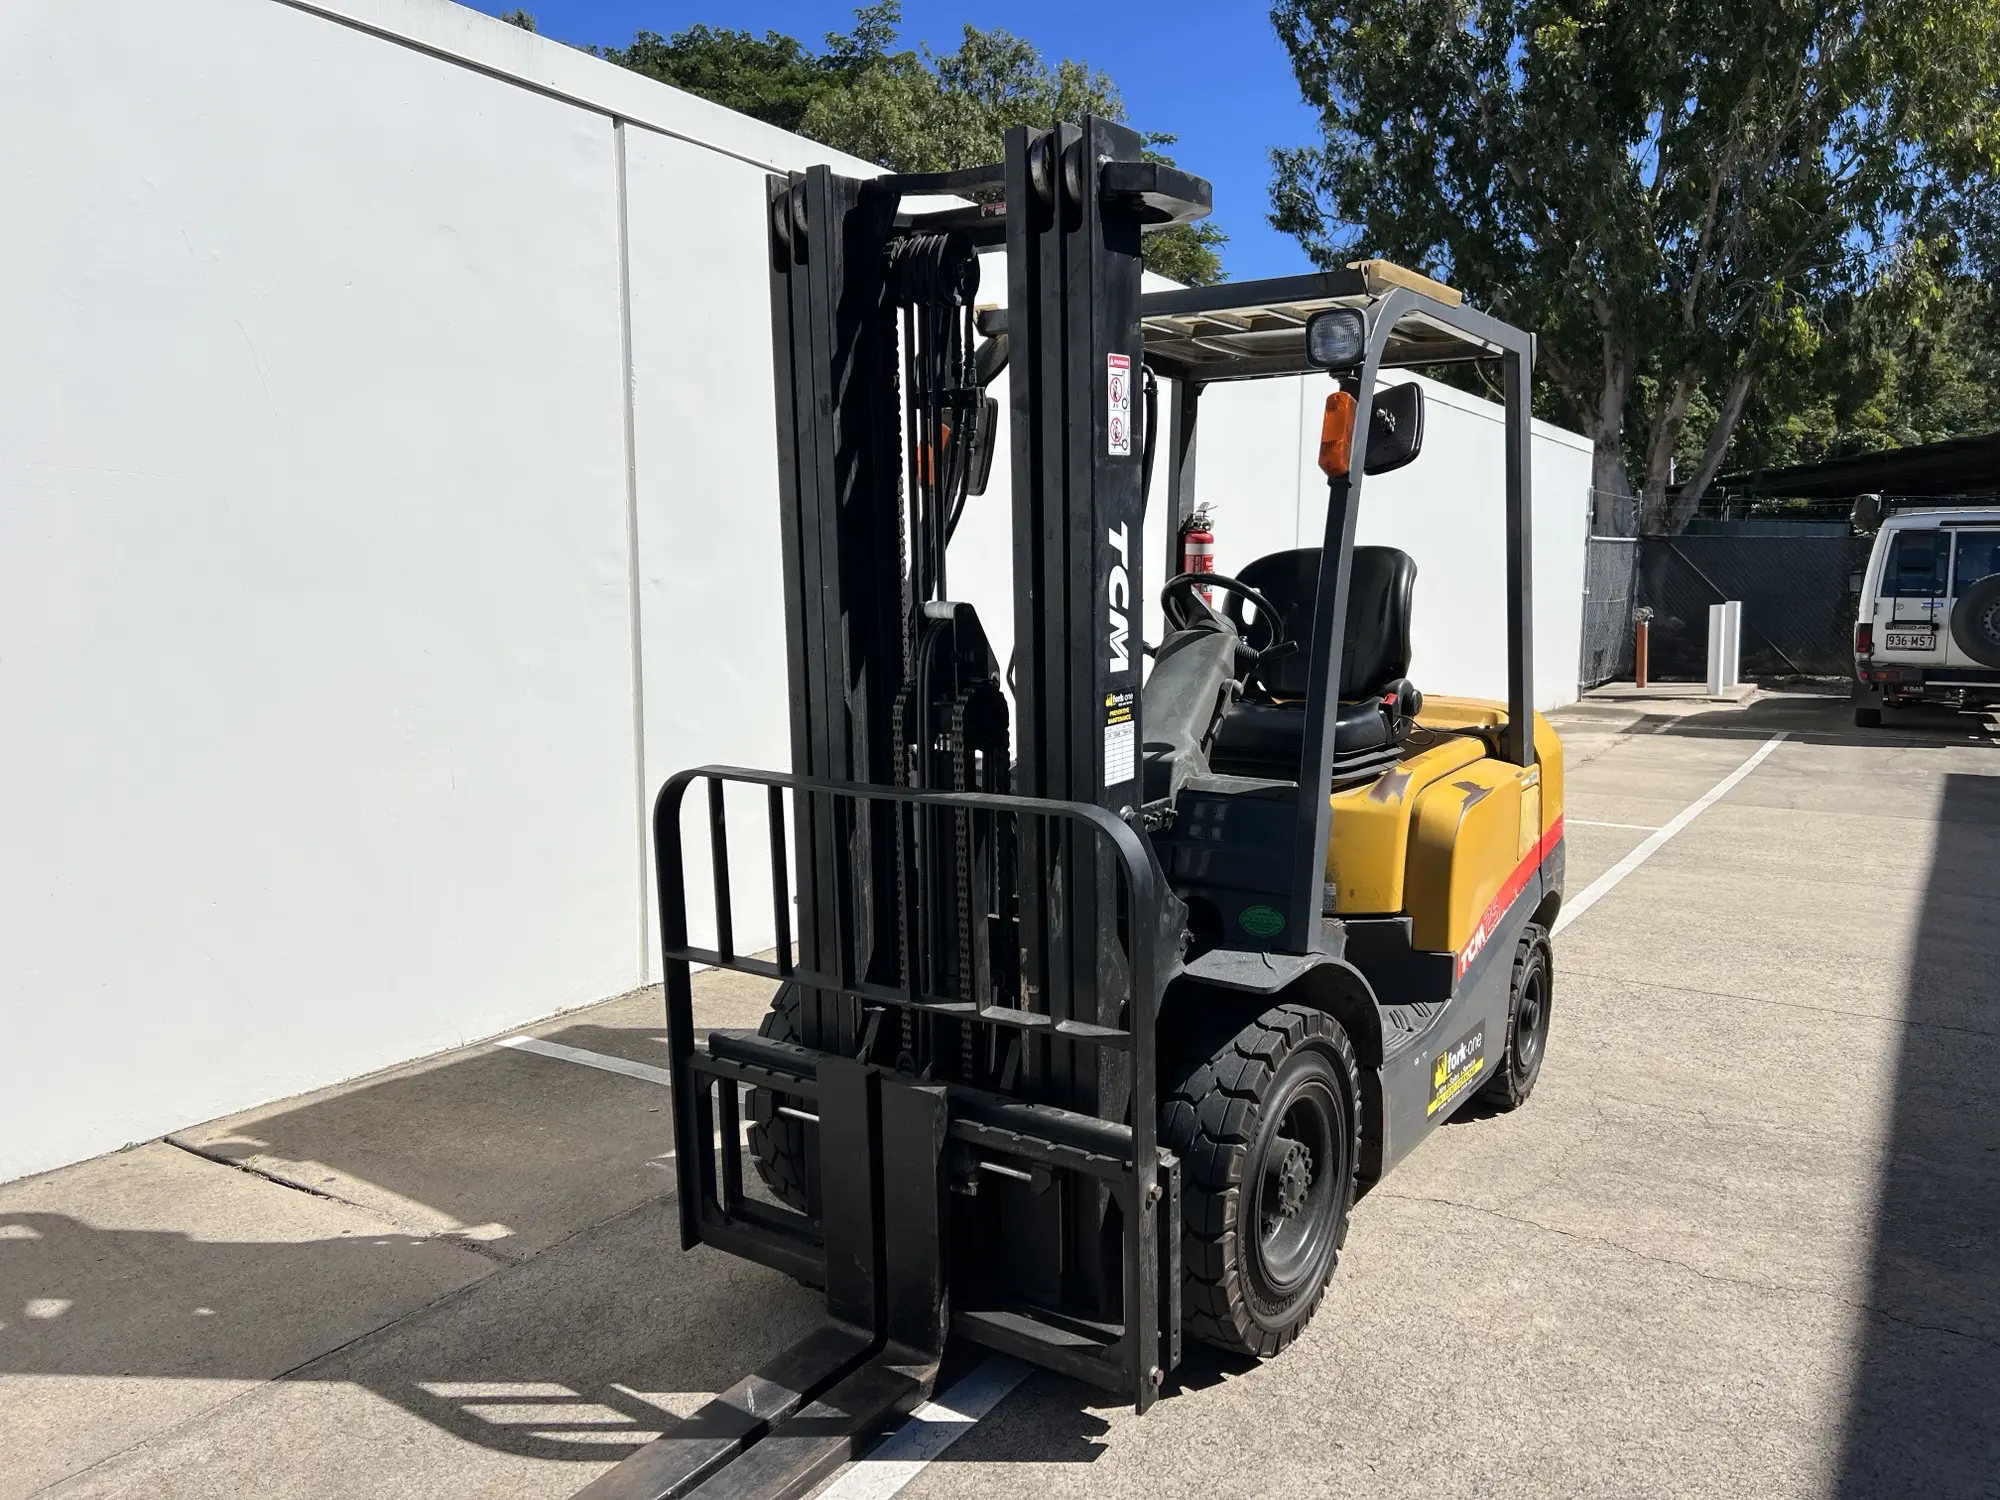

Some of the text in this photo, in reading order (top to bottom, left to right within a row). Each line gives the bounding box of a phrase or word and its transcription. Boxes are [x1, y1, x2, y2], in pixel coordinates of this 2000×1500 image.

[1109, 521, 1129, 673] TCM
[1461, 896, 1500, 974] TCM 25
